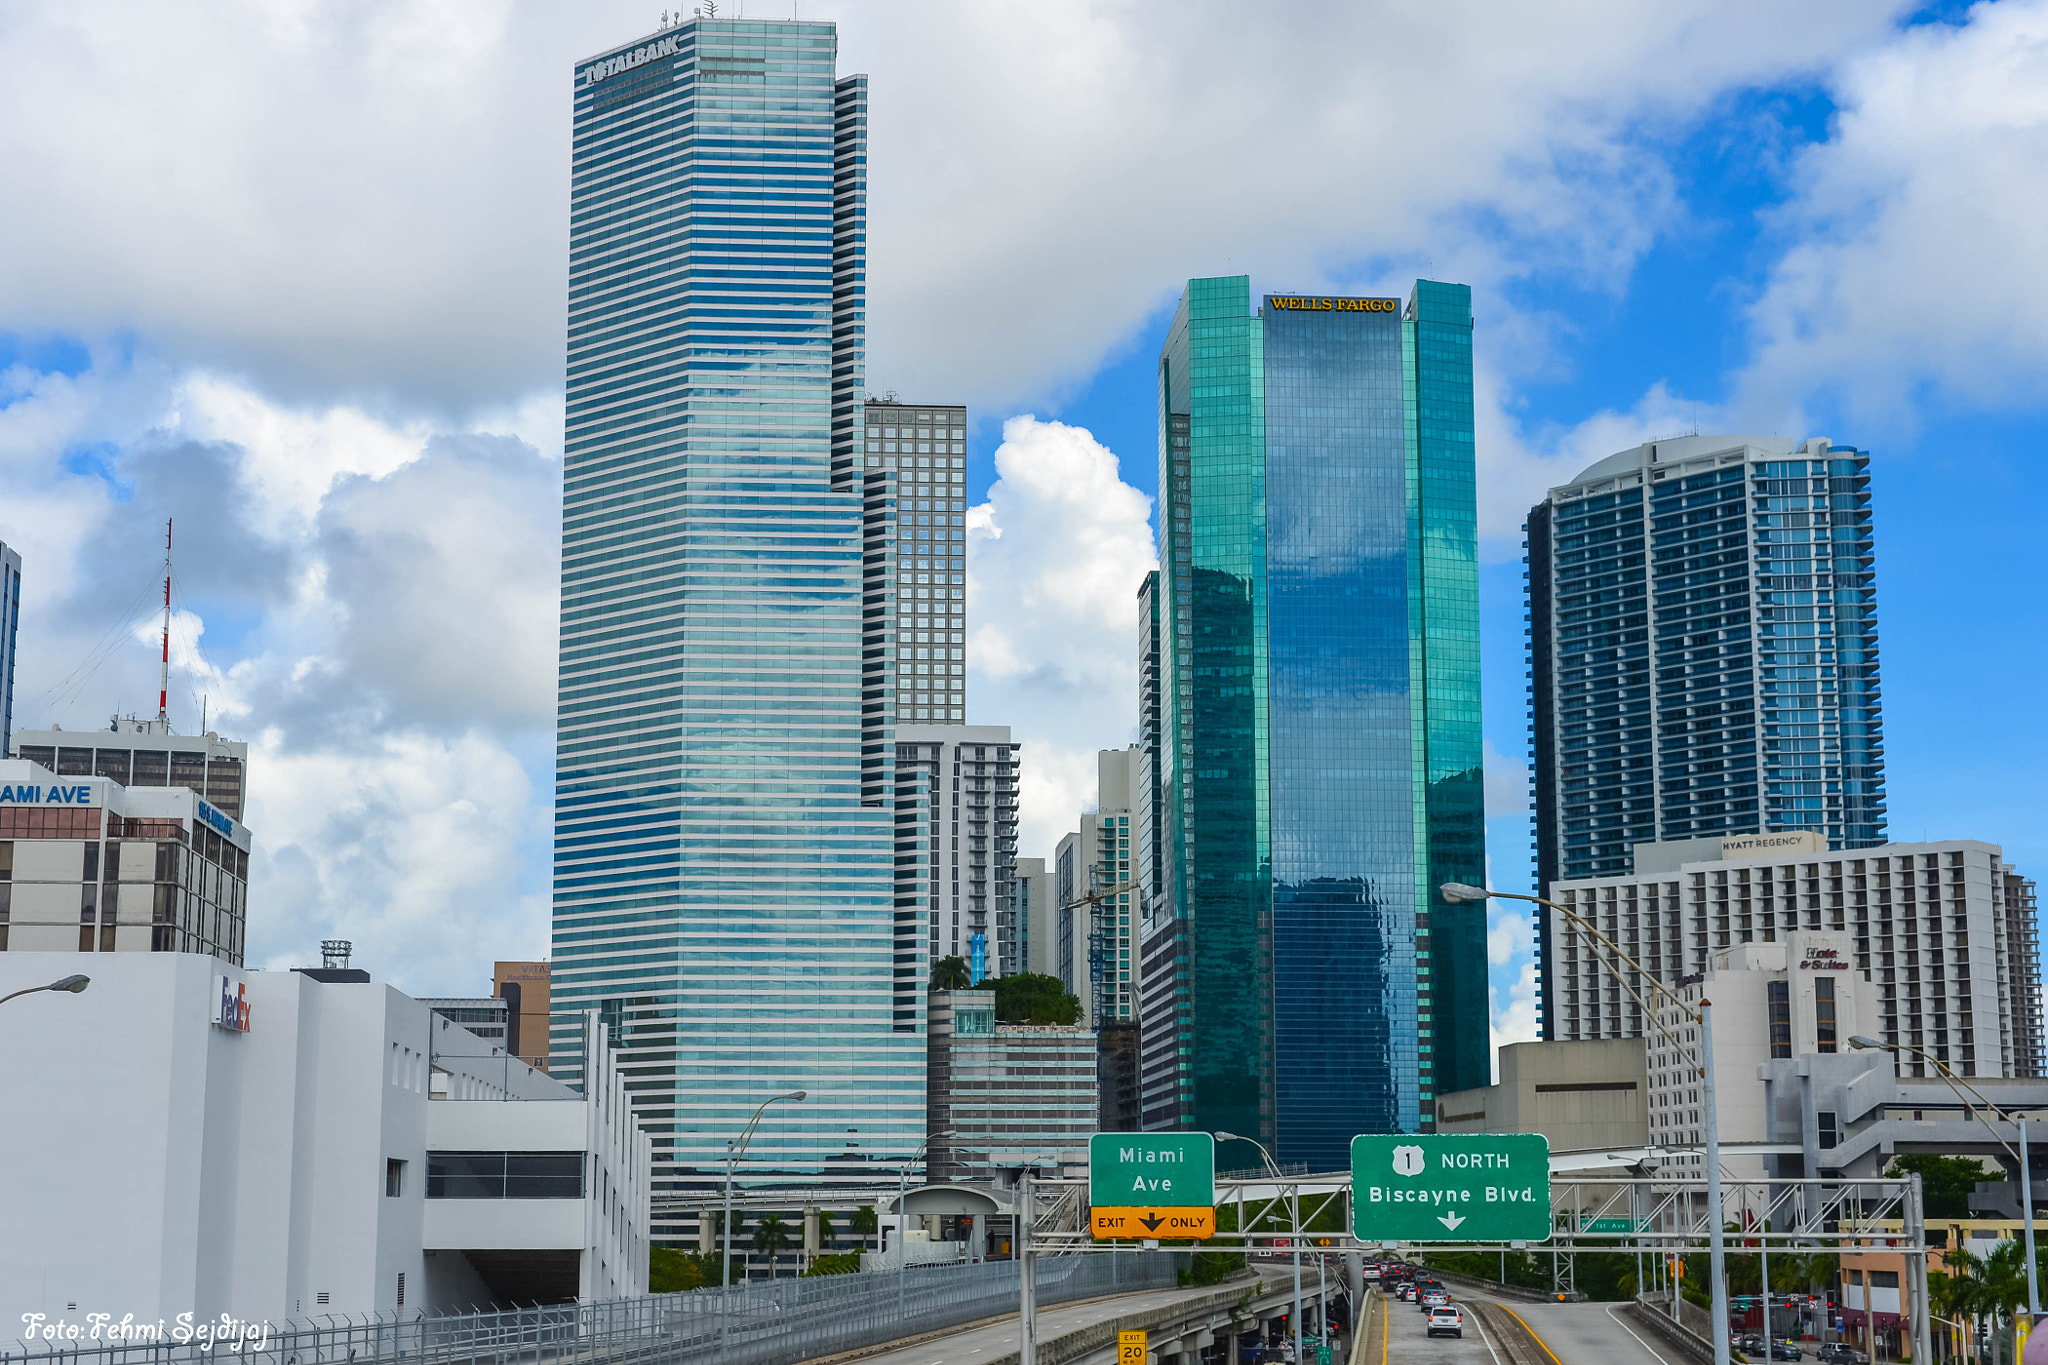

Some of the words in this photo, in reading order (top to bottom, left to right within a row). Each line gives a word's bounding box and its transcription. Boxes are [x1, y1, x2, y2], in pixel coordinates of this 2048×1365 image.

[1271, 297, 1332, 311] WELLS
[1336, 299, 1396, 312] FARGO
[46, 785, 91, 804] AVE
[1722, 840, 1754, 851] HYATT
[1755, 836, 1802, 848] REGENCY
[221, 975, 252, 1033] FedEx
[1120, 1147, 1184, 1163] Miami
[1405, 1152, 1411, 1170] 1
[1441, 1153, 1510, 1169] NORTH
[1132, 1175, 1172, 1191] Ave
[1369, 1186, 1471, 1206] Biscayne
[1485, 1186, 1536, 1202] Blvd.
[1098, 1217, 1126, 1228] EXIT
[1170, 1217, 1206, 1228] ONLY
[1124, 1347, 1142, 1358] 20
